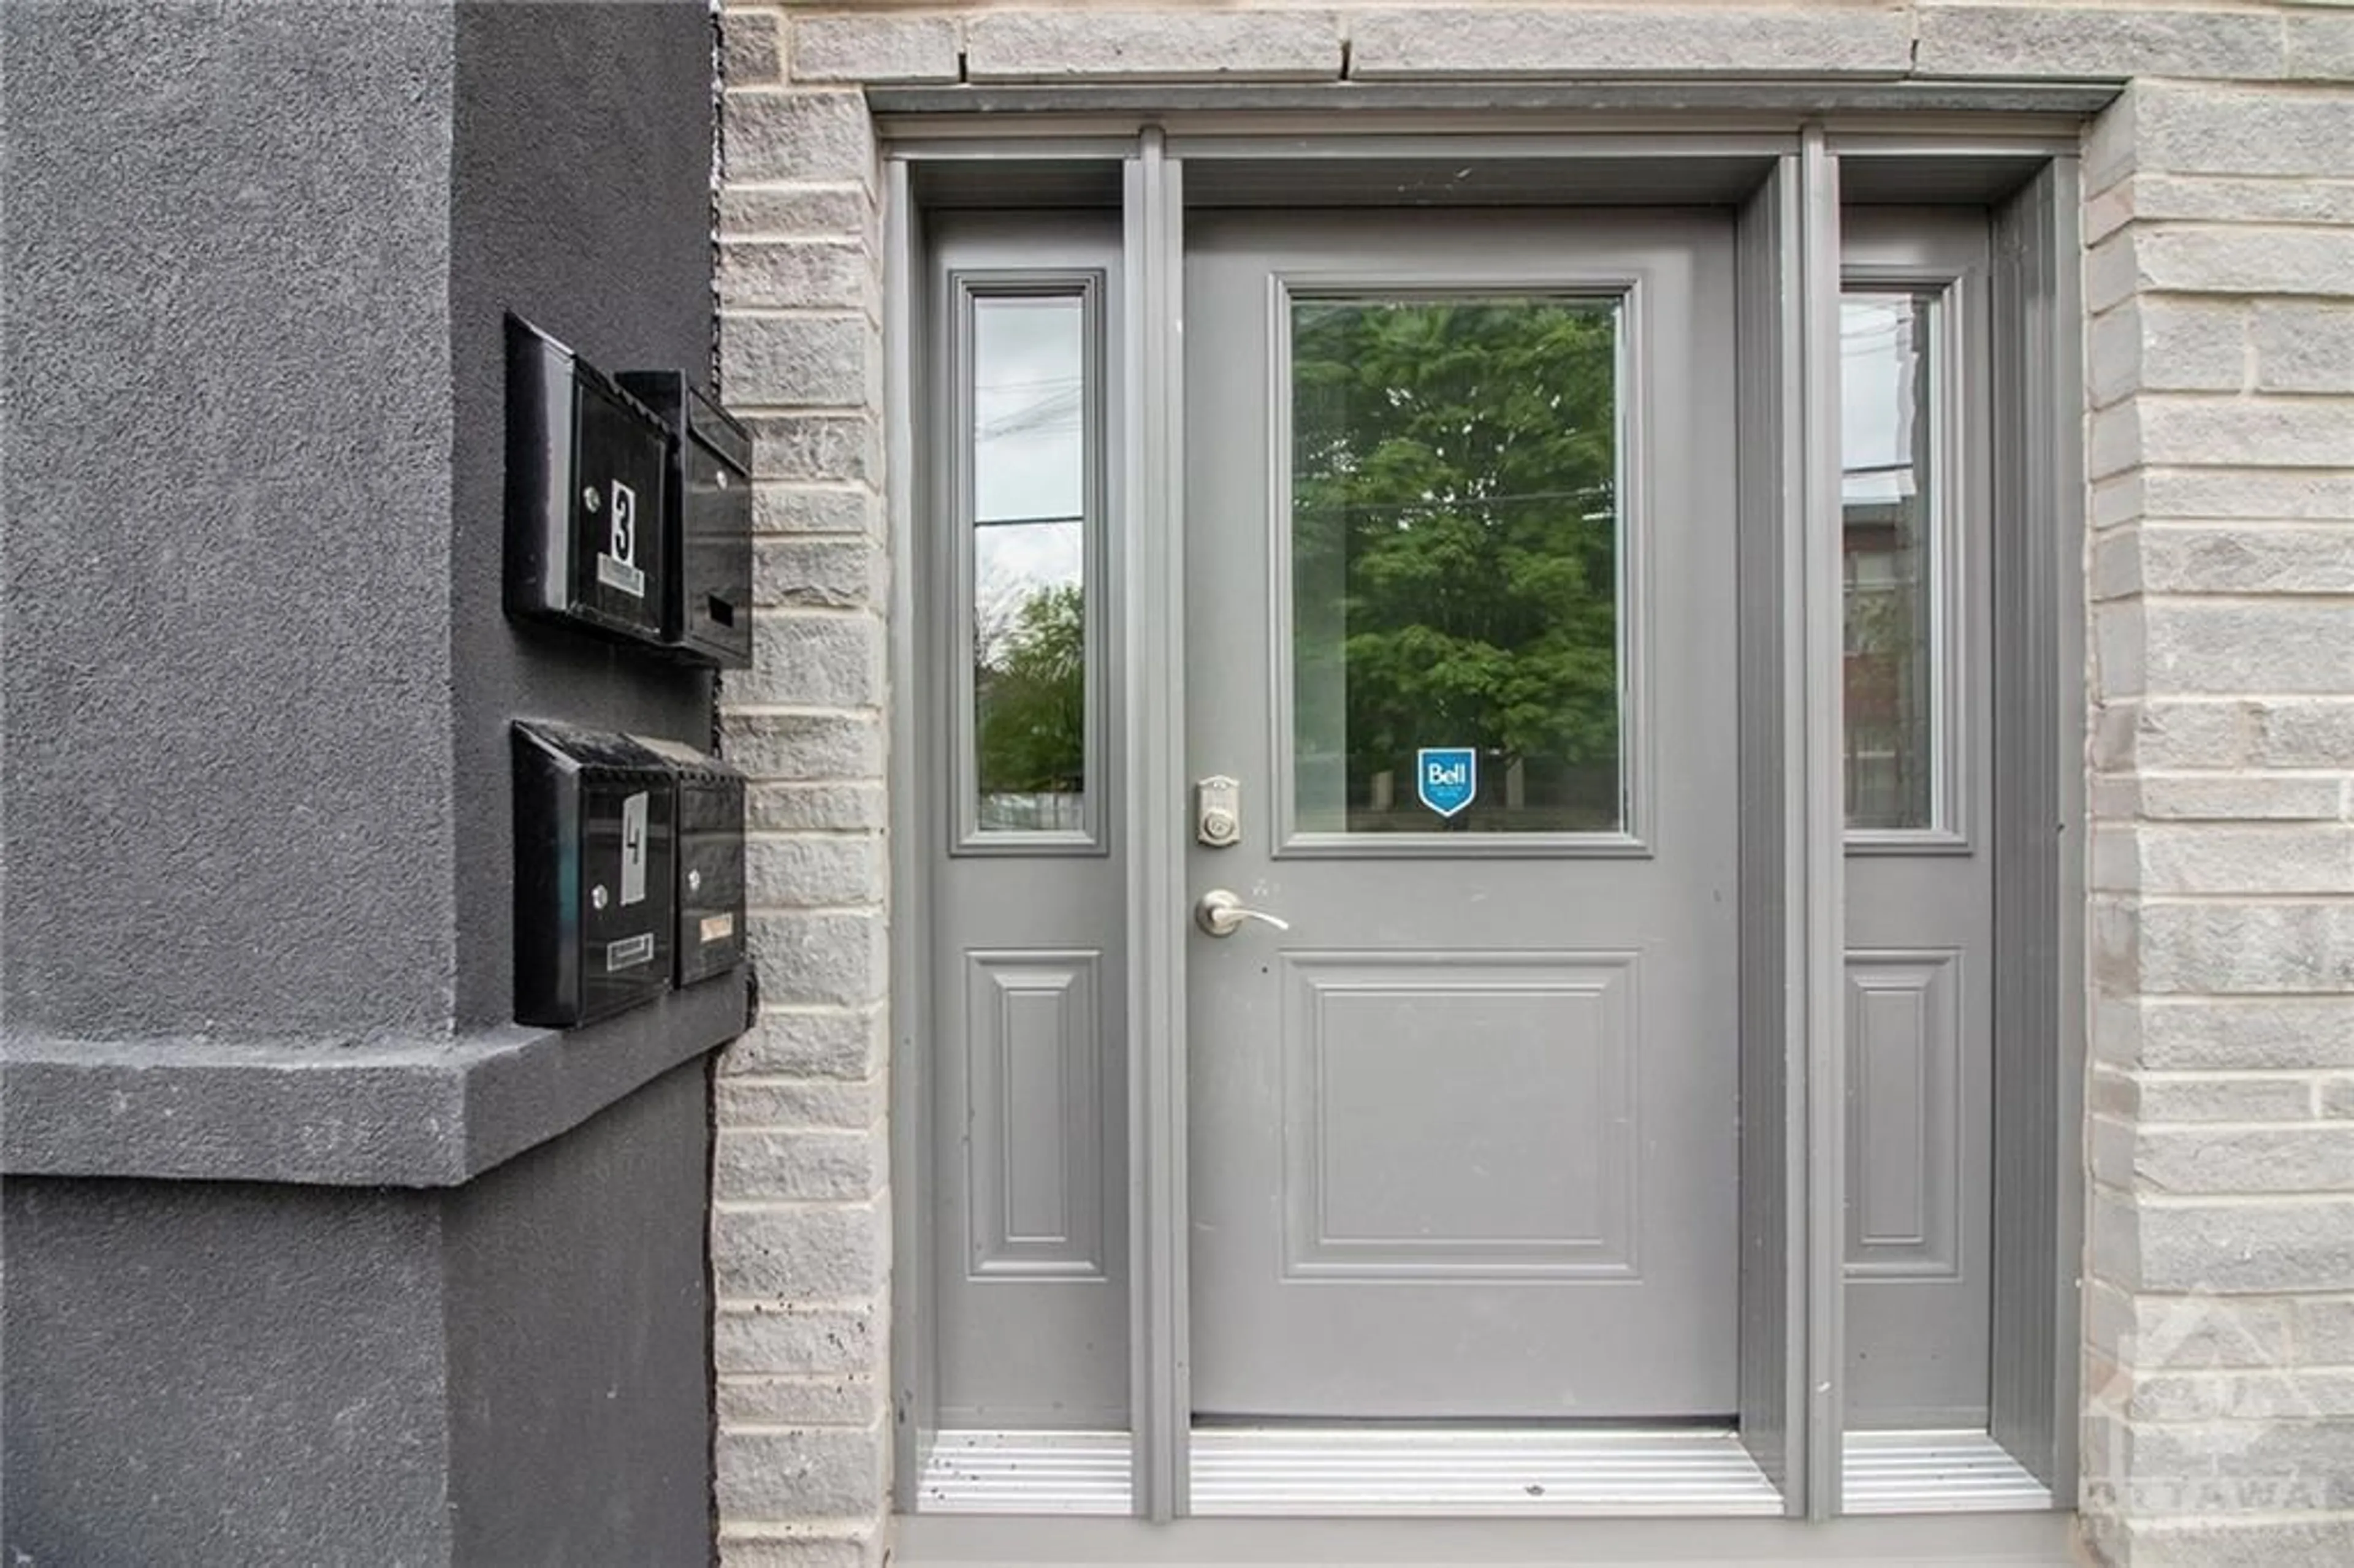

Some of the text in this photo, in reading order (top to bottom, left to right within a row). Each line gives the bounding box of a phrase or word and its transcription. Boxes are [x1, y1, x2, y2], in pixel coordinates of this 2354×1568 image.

[615, 489, 630, 561] 3
[1428, 762, 1466, 785] Bell
[627, 813, 640, 866] 4
